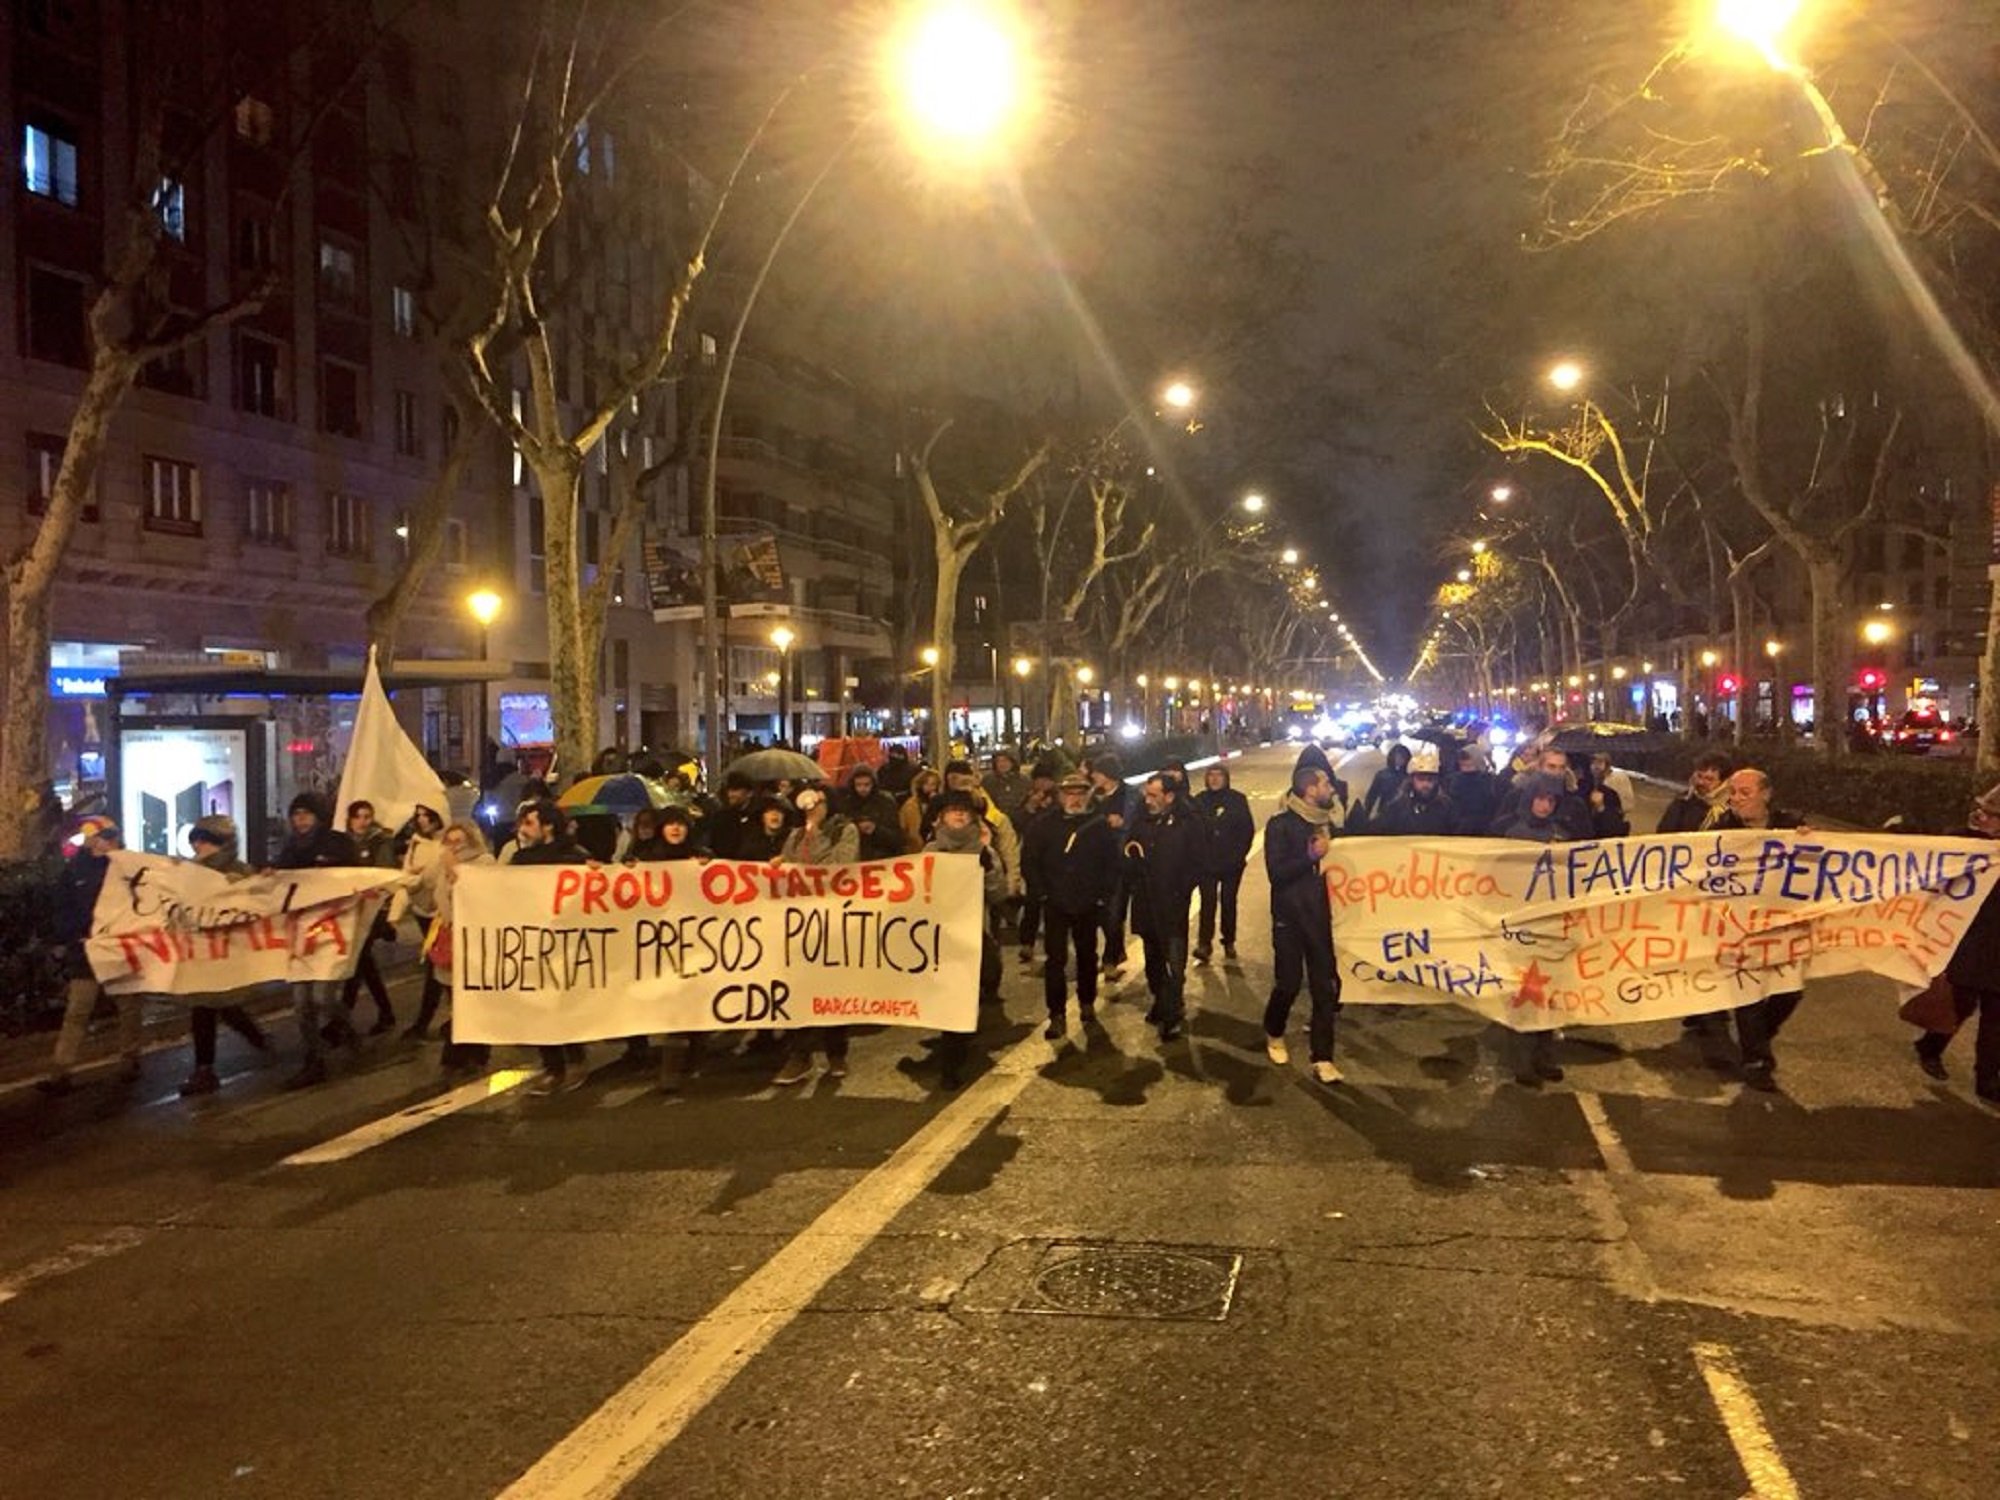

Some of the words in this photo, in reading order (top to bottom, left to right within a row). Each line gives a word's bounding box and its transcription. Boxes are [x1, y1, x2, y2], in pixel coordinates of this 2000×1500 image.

[553, 868, 673, 915] PROU
[700, 855, 935, 905] OSTATGES!
[1325, 849, 1512, 912] República
[1568, 842, 1693, 899] FAVOR
[1706, 835, 1740, 868] de
[462, 925, 620, 992] LLIBERTAT
[635, 915, 763, 981] PRESOS
[785, 899, 941, 975] POLÍTICS!
[1382, 928, 1430, 963] EN
[712, 979, 792, 1024] CDR
[812, 995, 921, 1019] BARCELONETA
